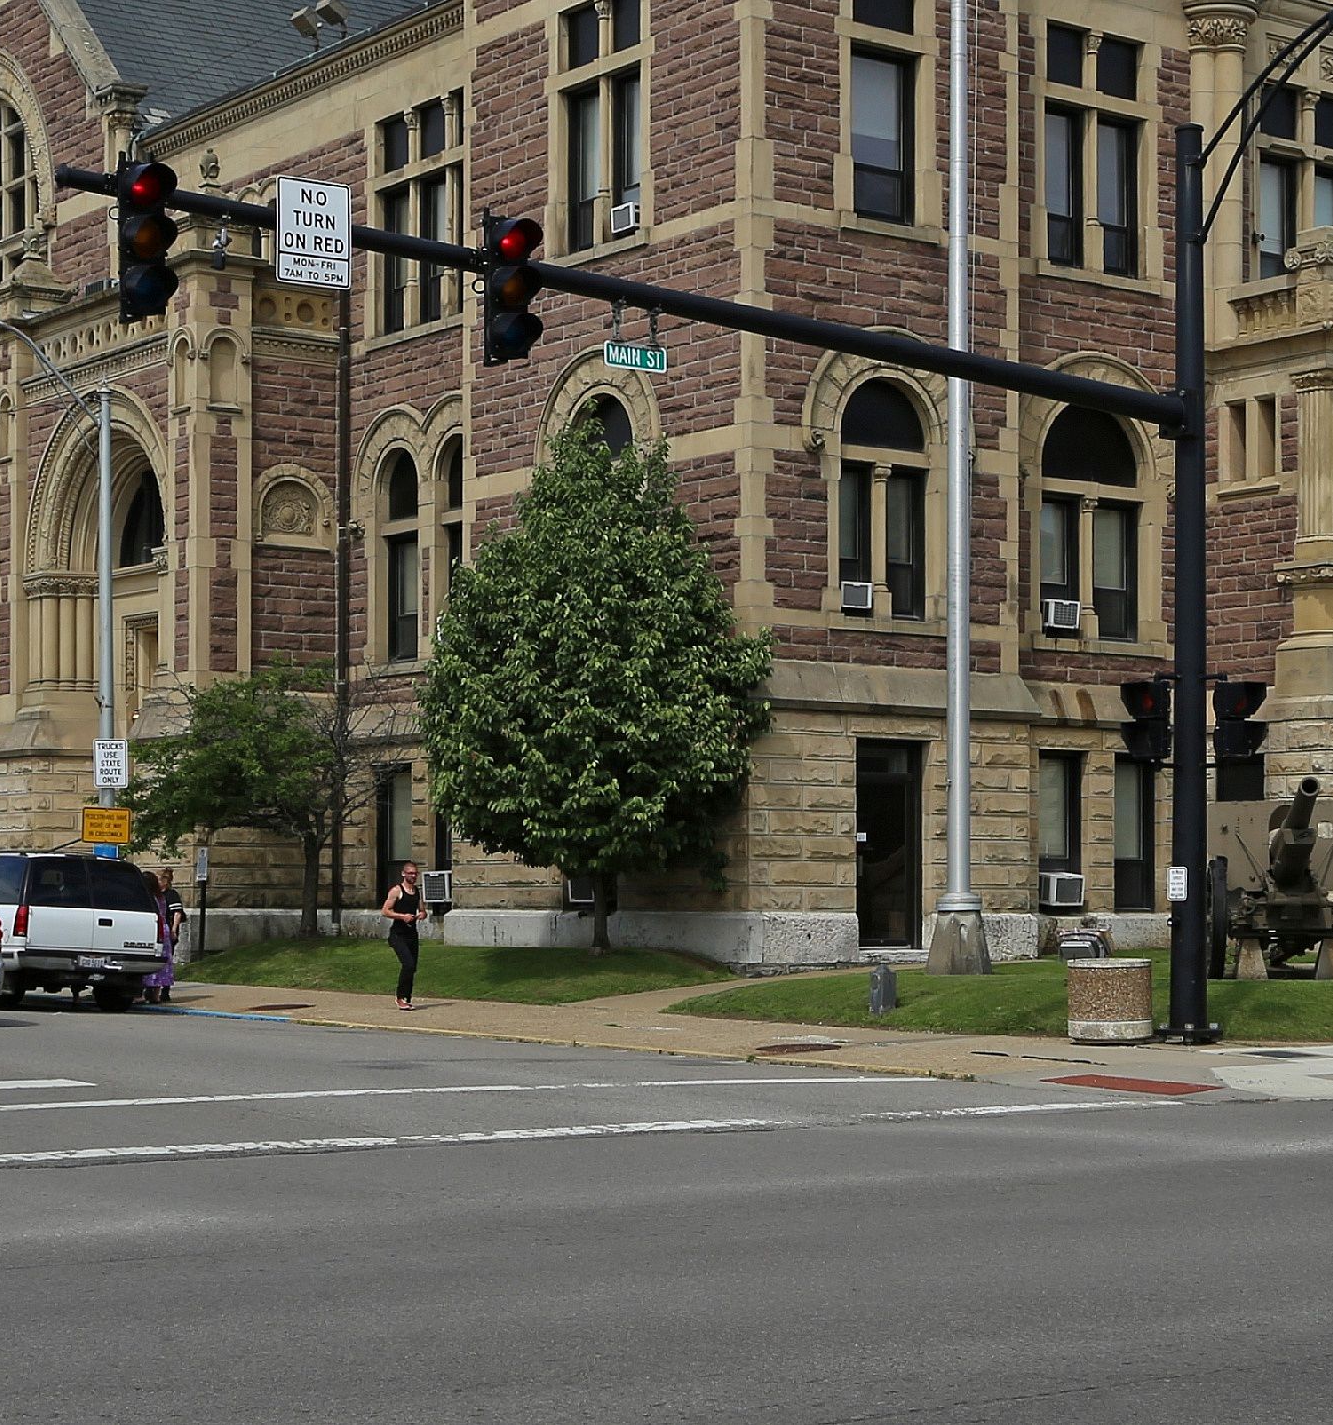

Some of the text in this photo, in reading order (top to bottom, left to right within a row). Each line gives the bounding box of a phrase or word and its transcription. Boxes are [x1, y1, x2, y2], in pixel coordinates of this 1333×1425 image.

[301, 188, 327, 206] NO
[293, 210, 335, 230] TURN
[284, 232, 344, 253] ON RED
[293, 258, 336, 270] MON-FRI
[284, 268, 344, 282] 7AM TO 5PM
[609, 345, 662, 368] MAIN ST
